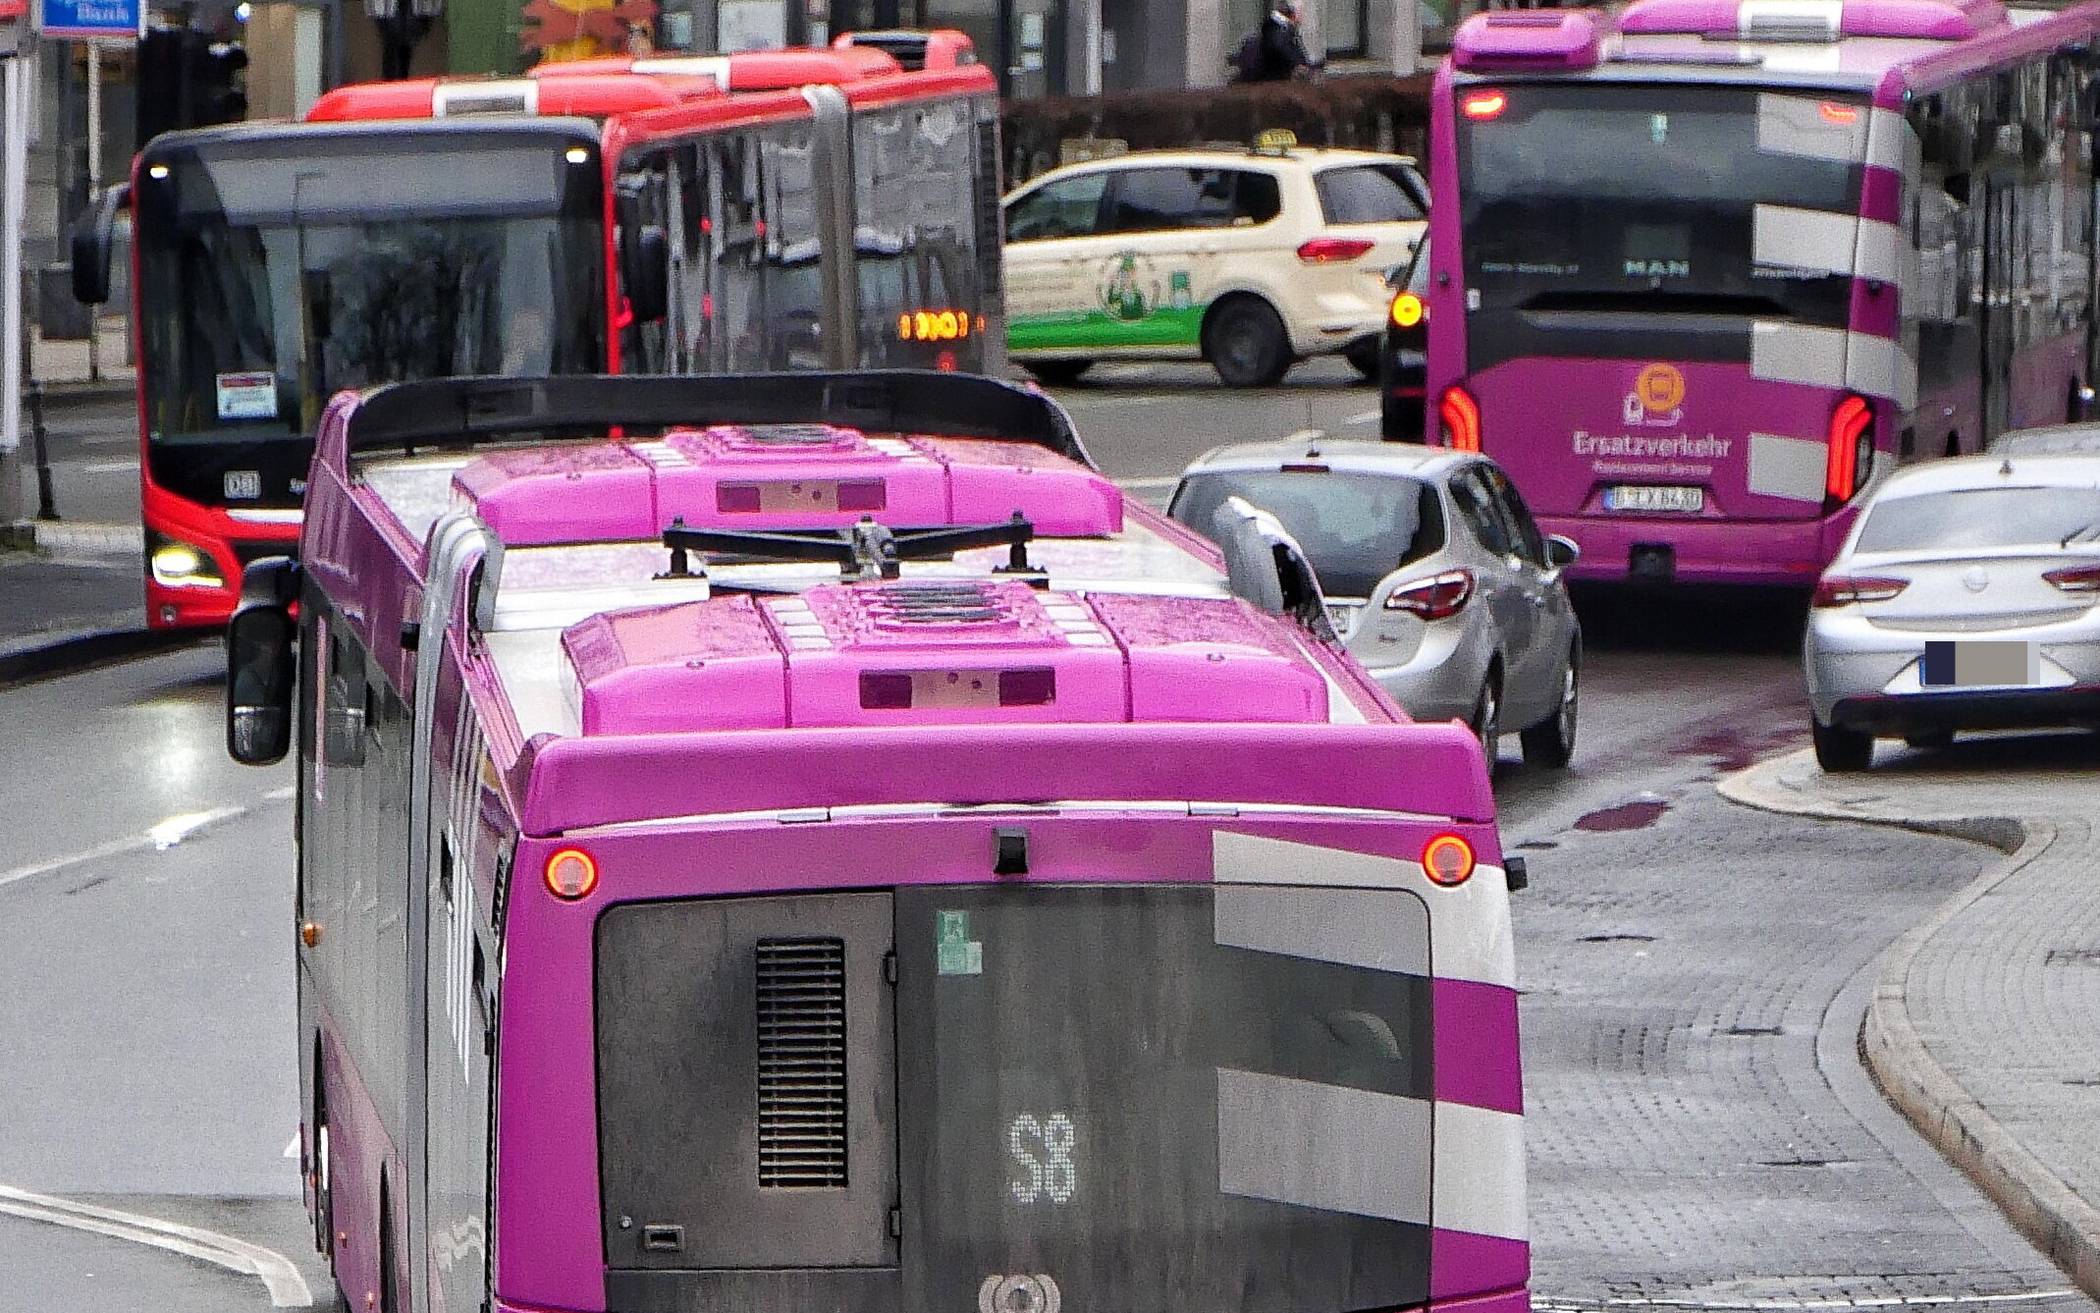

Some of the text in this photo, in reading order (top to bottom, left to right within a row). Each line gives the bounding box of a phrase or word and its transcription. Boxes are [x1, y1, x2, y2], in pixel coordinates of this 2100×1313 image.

[1624, 260, 1690, 277] MAN
[1572, 431, 1732, 458] Ersatzverkehr
[1010, 1113, 1075, 1204] S8
